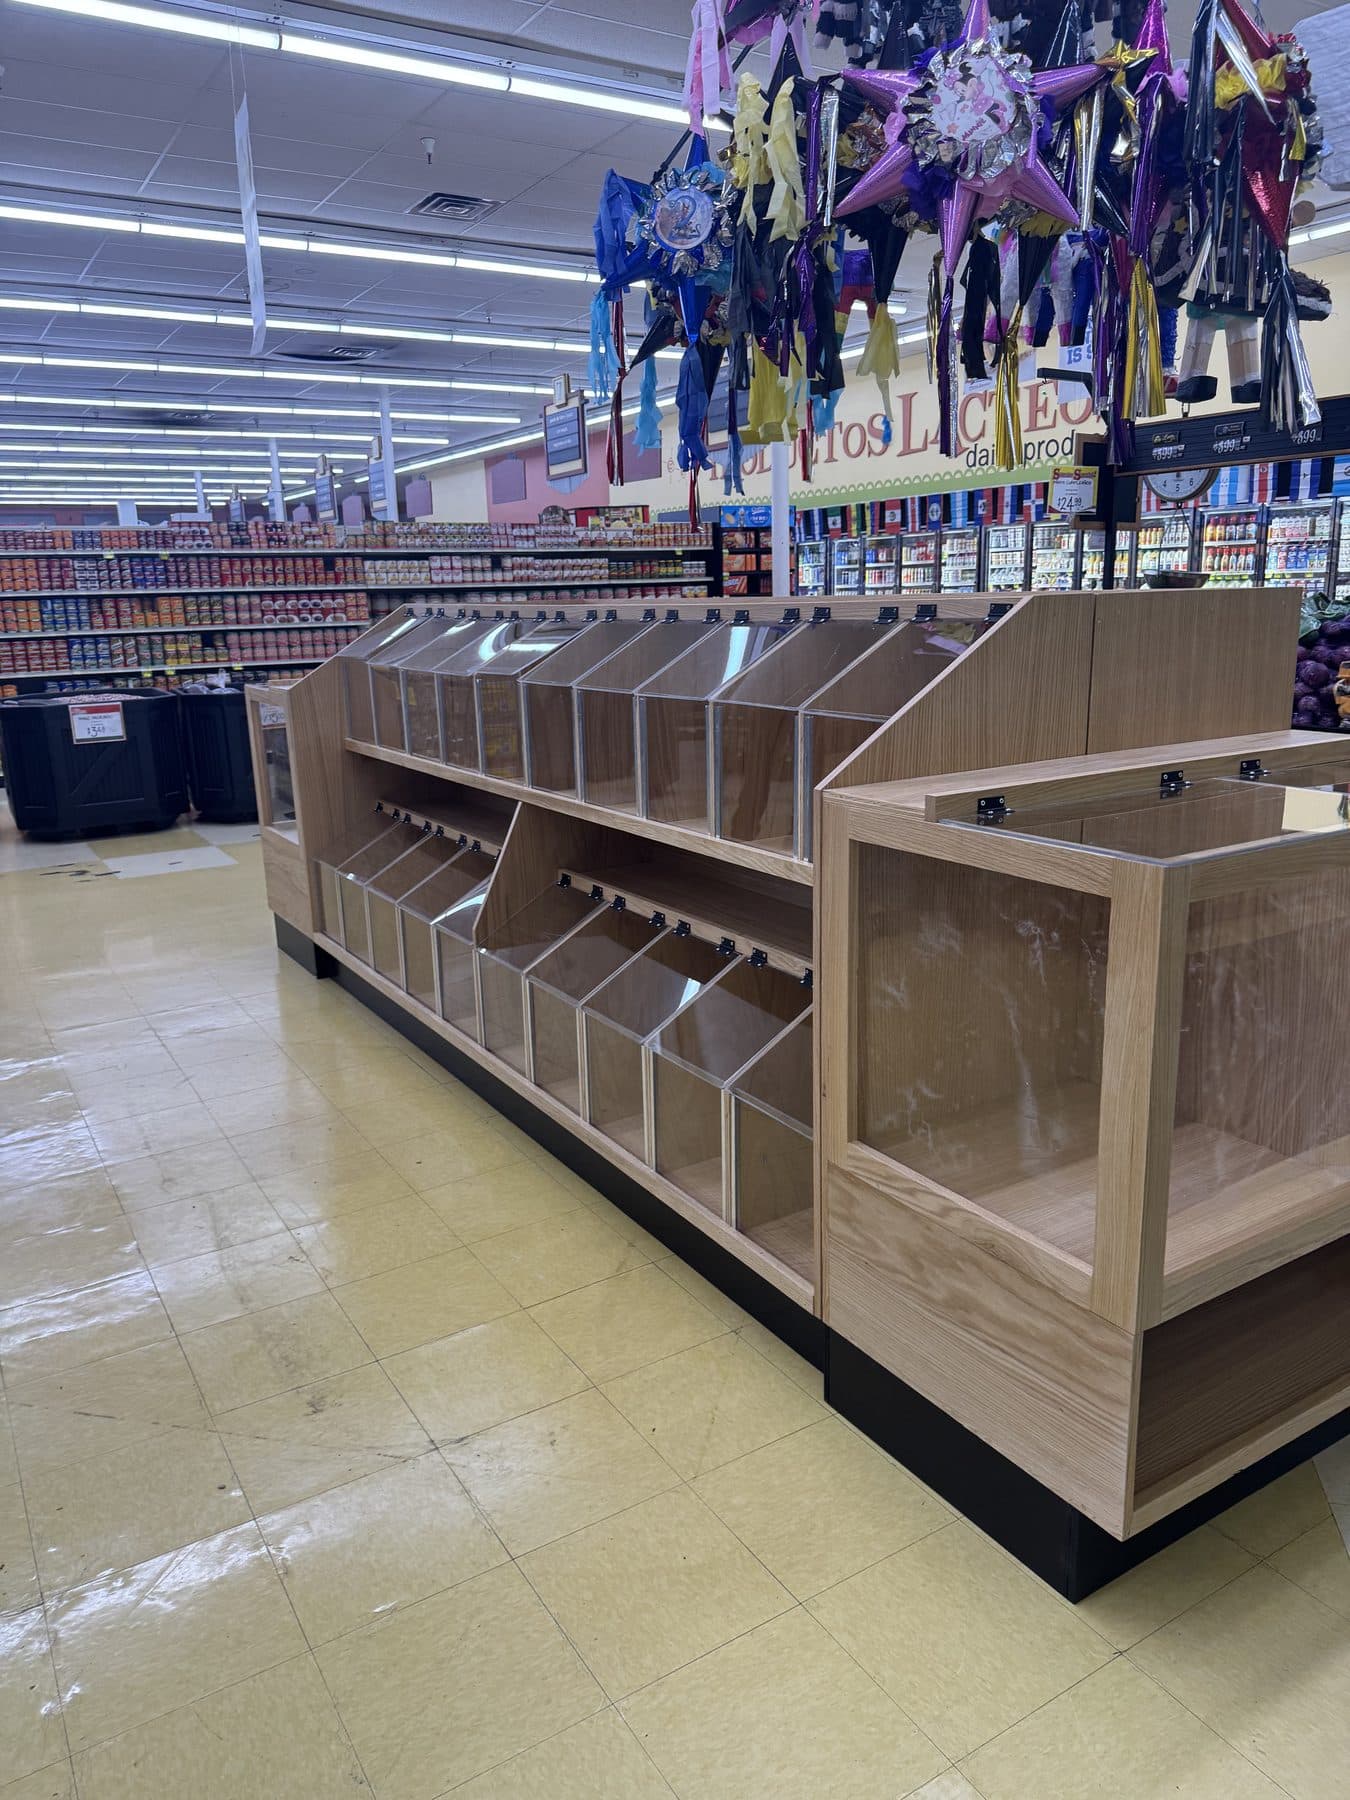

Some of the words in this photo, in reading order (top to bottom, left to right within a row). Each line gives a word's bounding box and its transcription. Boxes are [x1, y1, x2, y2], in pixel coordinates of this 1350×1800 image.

[967, 444, 996, 468] dai
[1024, 430, 1075, 468] prod
[1189, 477, 1194, 486] 6
[1175, 483, 1180, 492] 5
